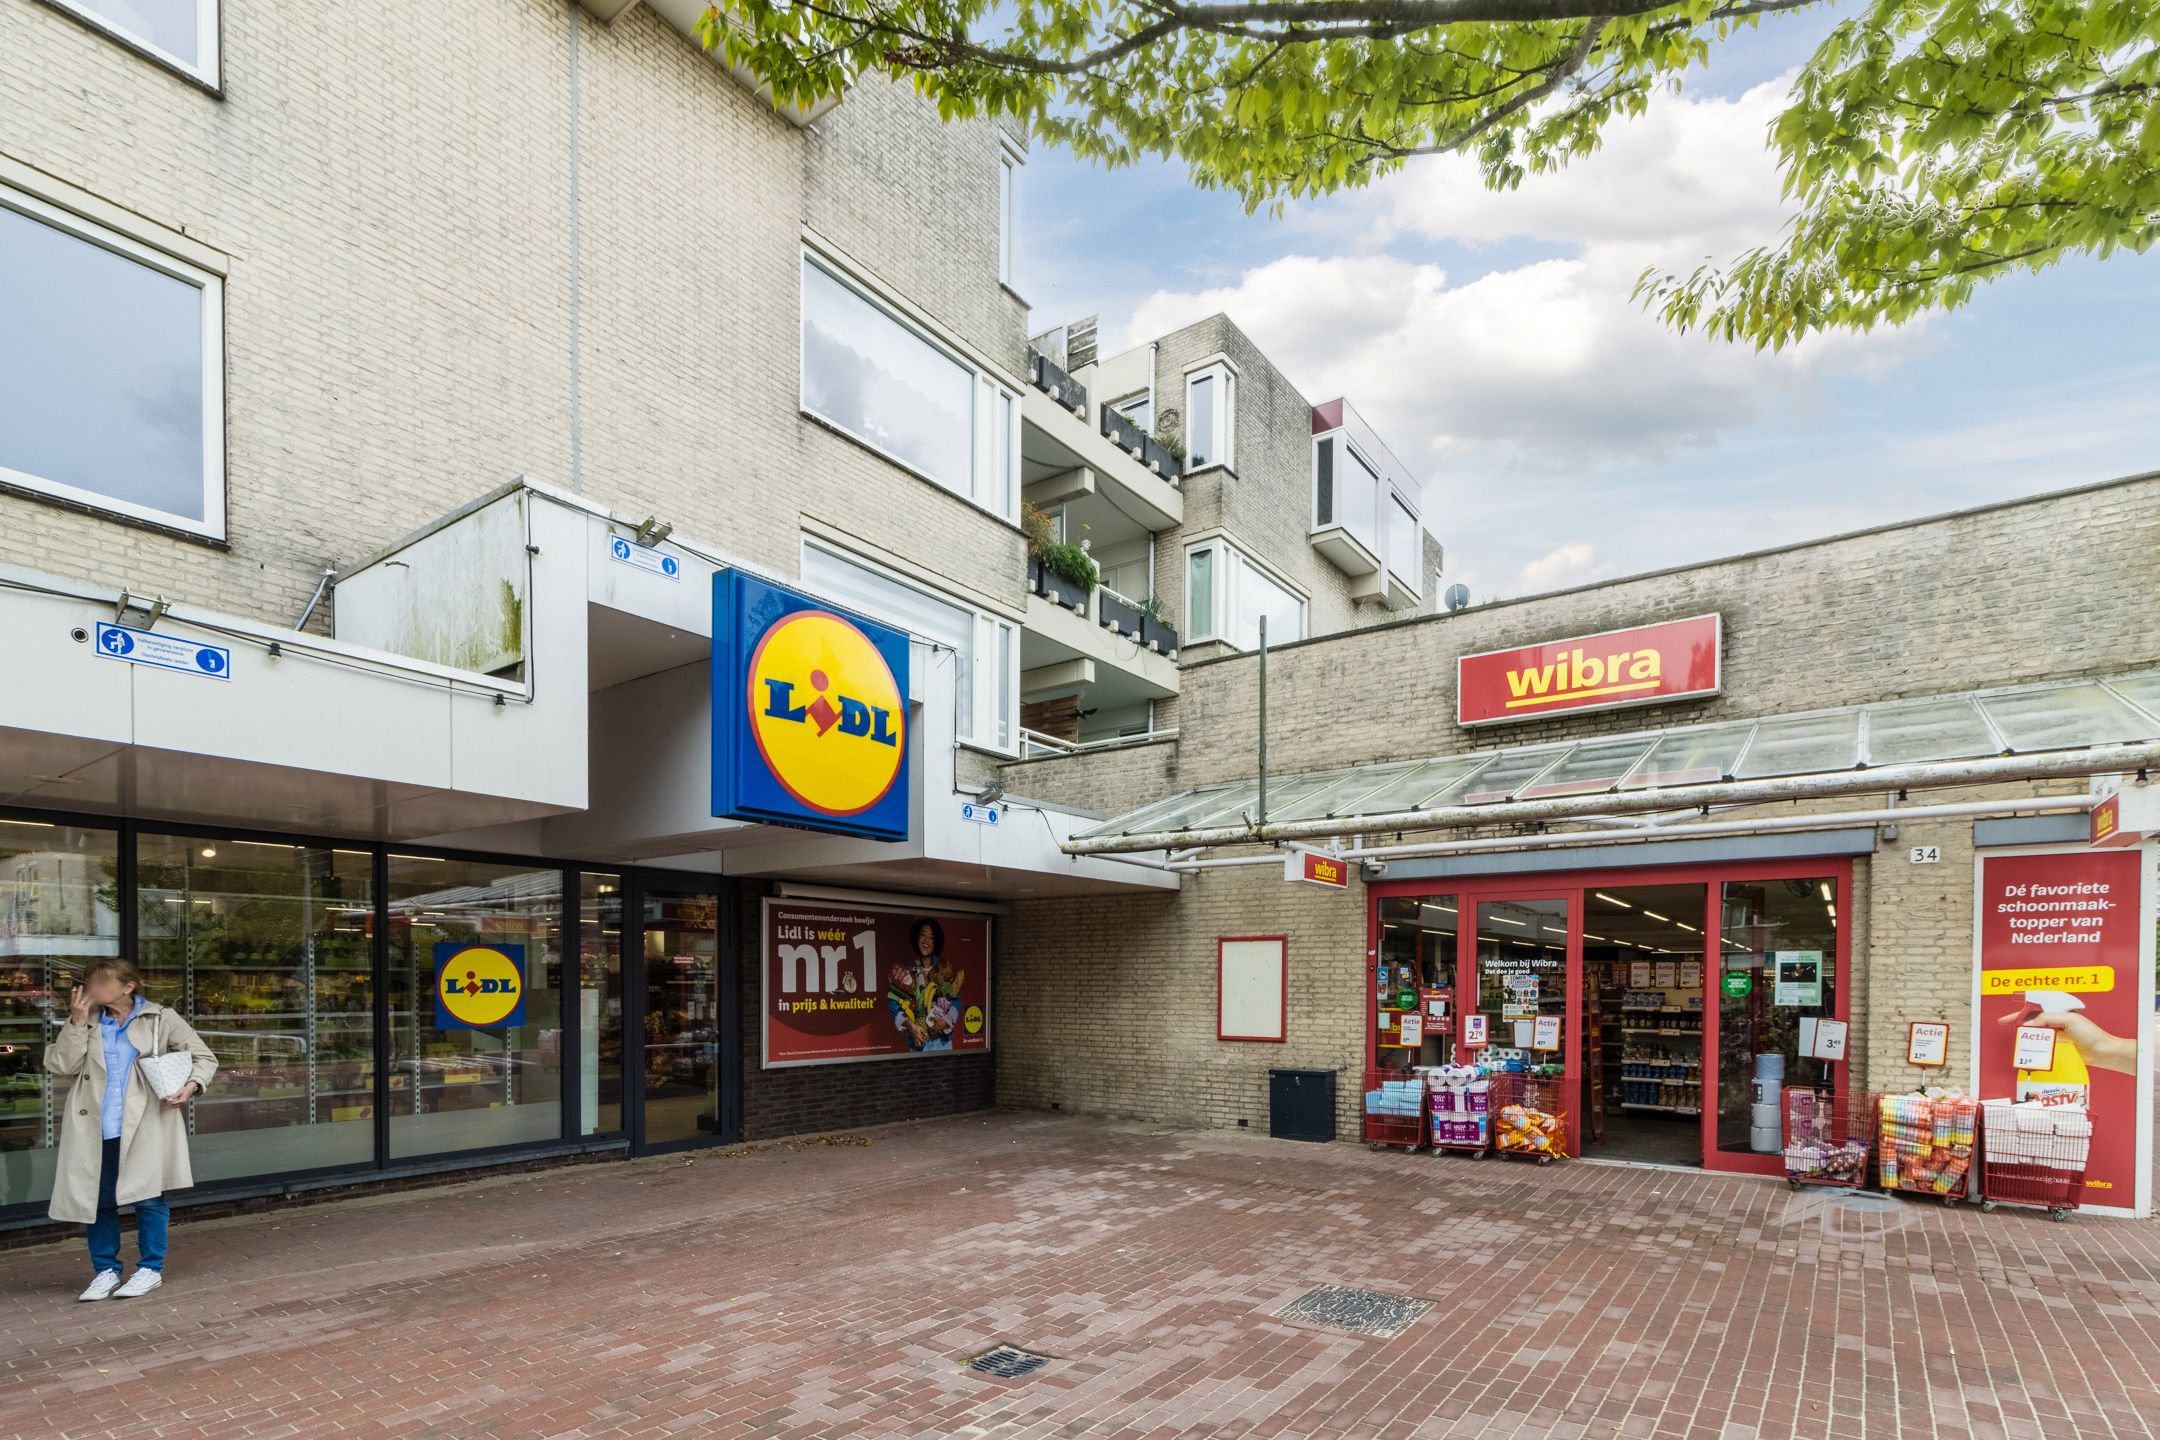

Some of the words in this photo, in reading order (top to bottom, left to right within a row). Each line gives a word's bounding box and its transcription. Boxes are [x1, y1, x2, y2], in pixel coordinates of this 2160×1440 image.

[1506, 648, 1661, 697] wibra
[1914, 848, 1937, 862] 34
[1315, 861, 1336, 878] wibra
[2005, 884, 2026, 897] Dé
[2030, 883, 2110, 897] favoriete
[1998, 898, 2116, 913] schoonmaak-
[778, 912, 853, 923] Consumentenonderzoek
[854, 916, 875, 925] bewijst
[2010, 917, 2068, 930] topper
[2071, 917, 2103, 927] van
[778, 925, 801, 939] Lidl
[805, 926, 815, 940] is
[818, 928, 846, 941] wéér
[2012, 931, 2101, 944] Nederland
[1520, 960, 1530, 968] bij
[1991, 977, 2010, 987] De
[2015, 976, 2060, 987] echte
[2065, 976, 2086, 985] nr.
[2091, 974, 2099, 984] 1
[779, 998, 789, 1011] in
[792, 998, 817, 1013] prijs
[820, 999, 827, 1010] &
[1916, 1028, 1943, 1036] Actie
[2021, 1032, 2051, 1041] Actie
[2085, 1180, 2113, 1188] wibra
